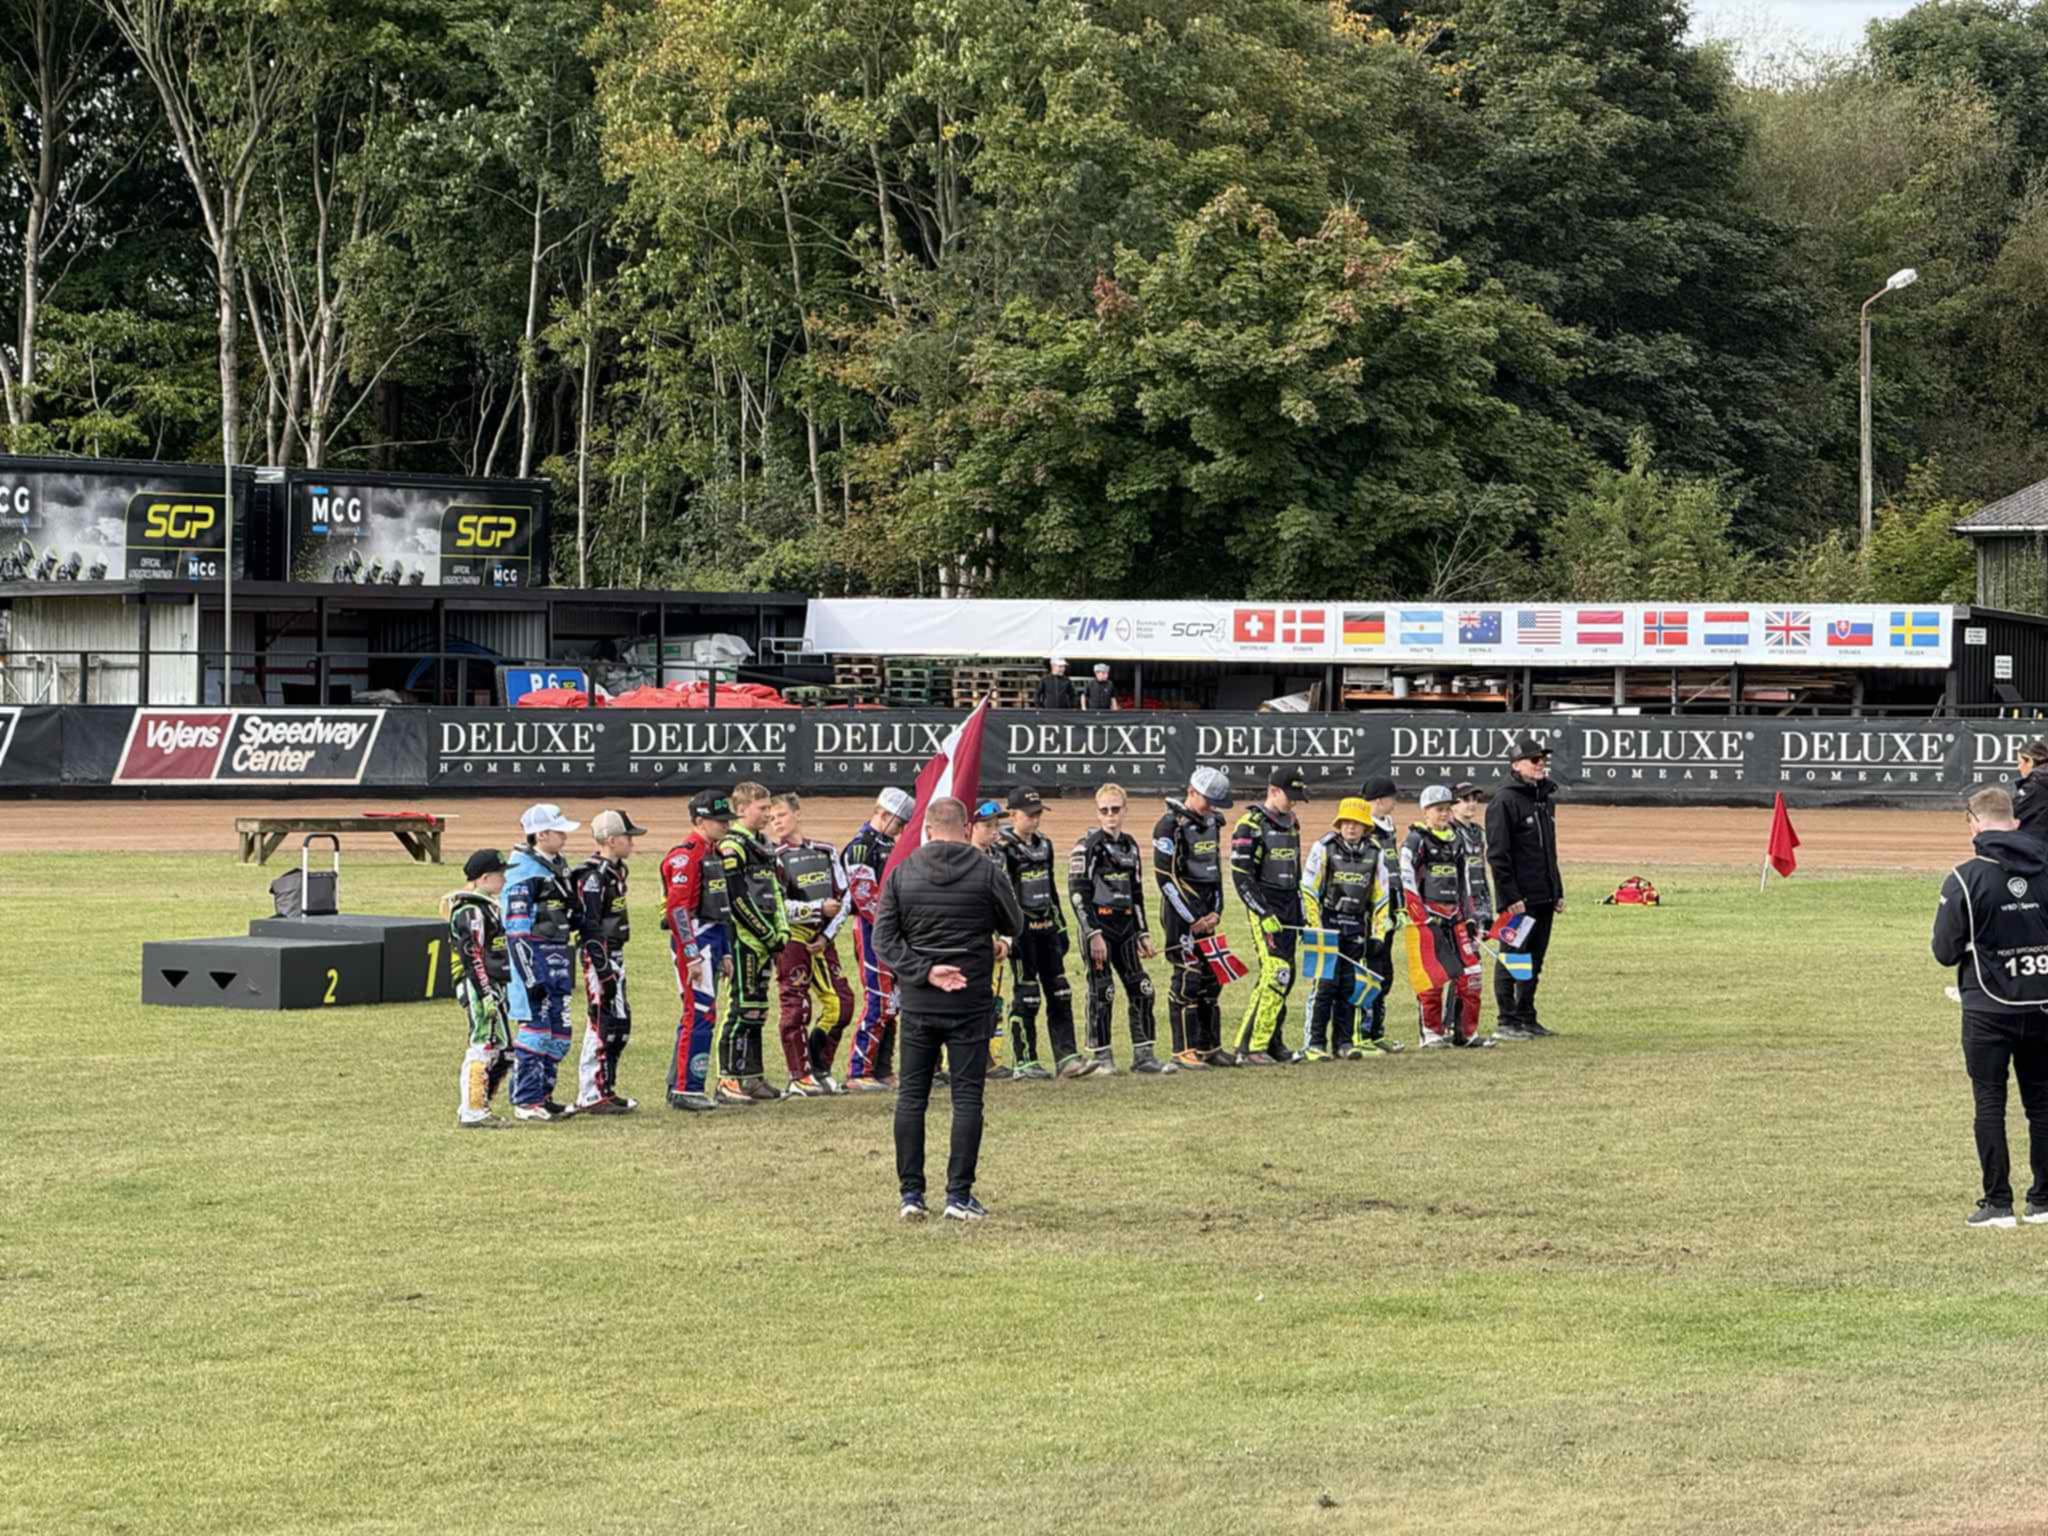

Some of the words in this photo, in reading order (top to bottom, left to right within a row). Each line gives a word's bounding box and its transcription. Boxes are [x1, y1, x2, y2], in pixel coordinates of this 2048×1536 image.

[144, 504, 215, 539] SGP
[312, 496, 361, 523] MCG
[456, 515, 516, 547] SGP
[188, 561, 216, 576] MCG
[494, 569, 517, 582] MCG
[146, 720, 221, 754] Vojens
[239, 716, 367, 750] Speedway
[440, 722, 596, 753] DELUXE
[629, 722, 787, 753] DELUXE
[1007, 724, 1166, 755] DELUXE
[1196, 726, 1355, 757] DELUXE
[1582, 729, 1744, 760] DELUXE
[1781, 732, 1944, 763] DELUXE
[232, 746, 315, 772] Center
[440, 762, 596, 773] HOMEART
[629, 762, 787, 773] HOMEART
[1007, 763, 1166, 774] HOMEART
[1582, 768, 1744, 780] HOMEART
[1781, 770, 1944, 782] HOMEART
[425, 939, 441, 997] 1
[2005, 954, 2048, 977] 139
[323, 968, 339, 1003] 2
